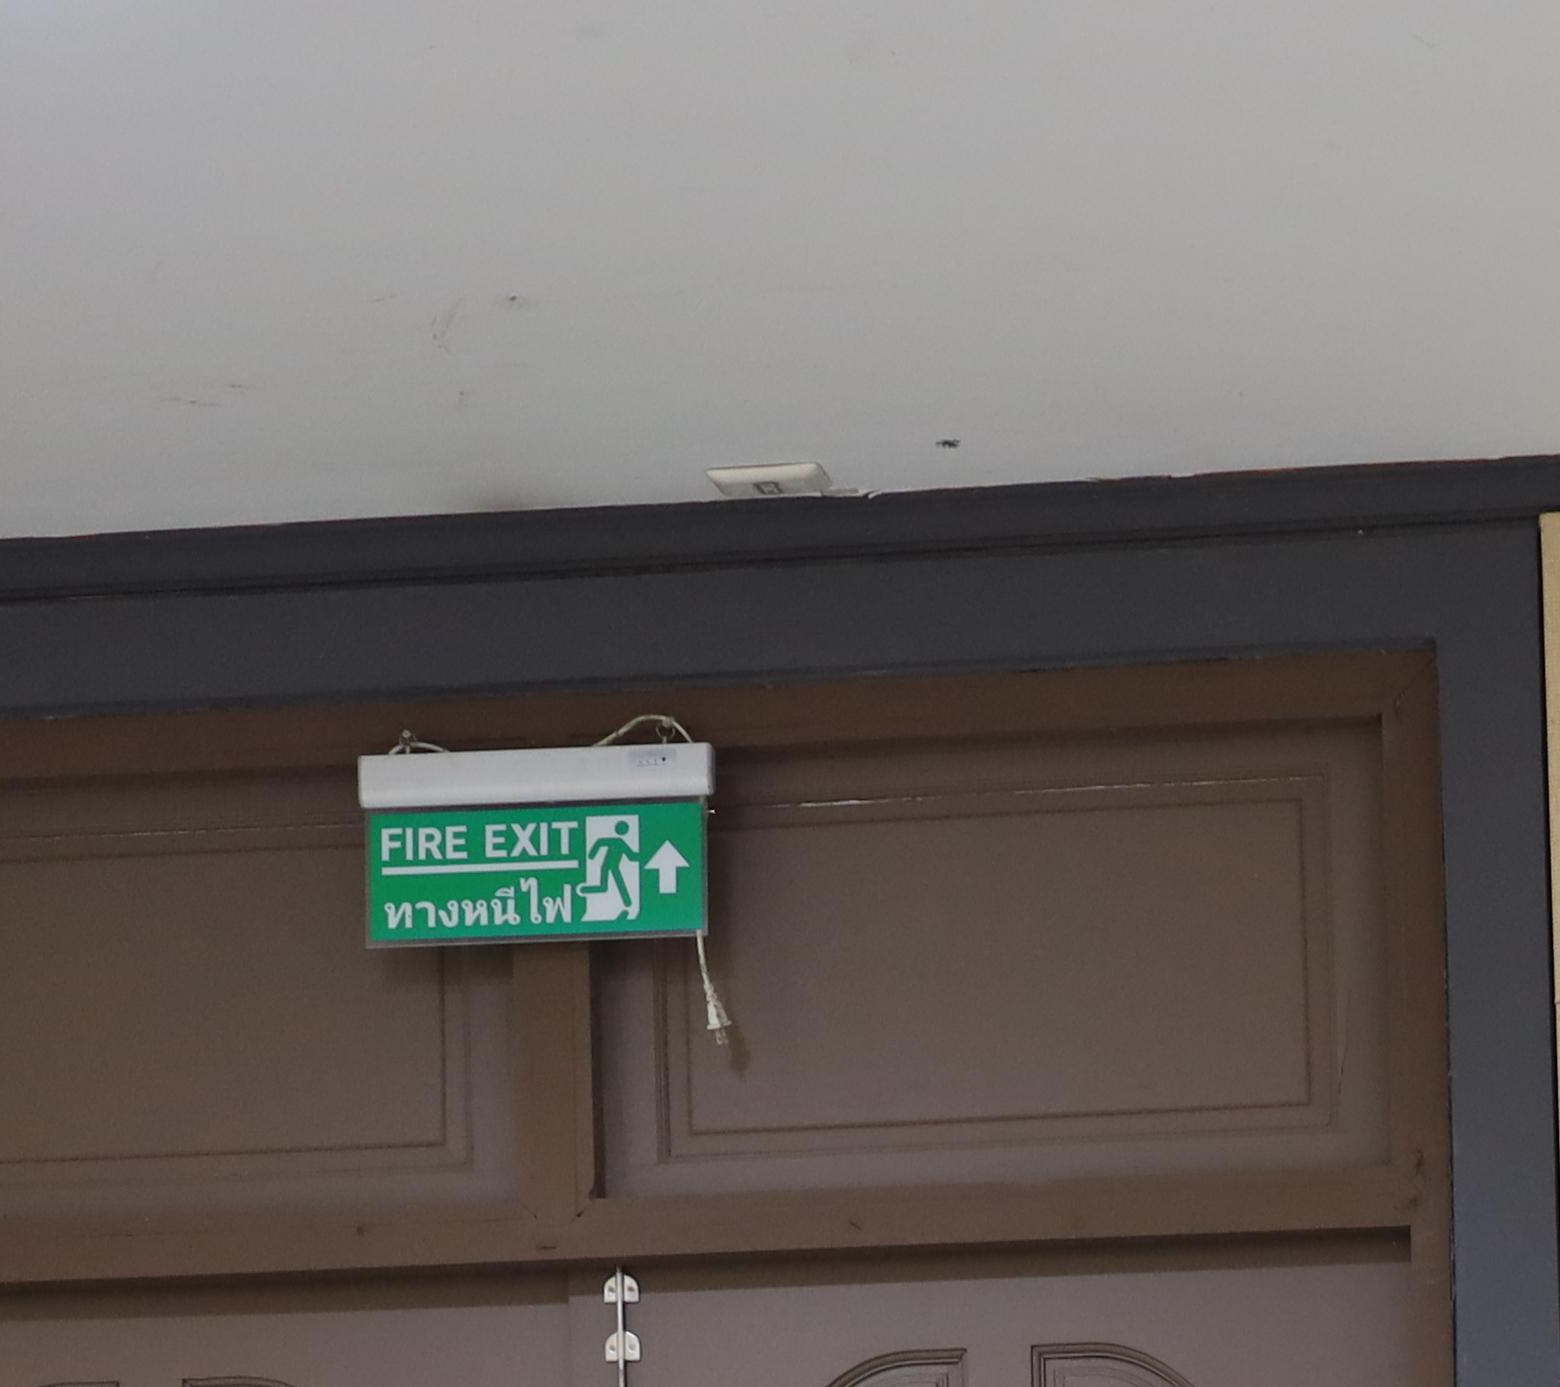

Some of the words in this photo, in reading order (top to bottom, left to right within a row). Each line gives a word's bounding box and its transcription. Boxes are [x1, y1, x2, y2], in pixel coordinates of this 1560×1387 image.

[380, 825, 468, 861] FIRE
[484, 821, 578, 857] EXIT
[384, 877, 572, 929] ทางหนีไฟ
